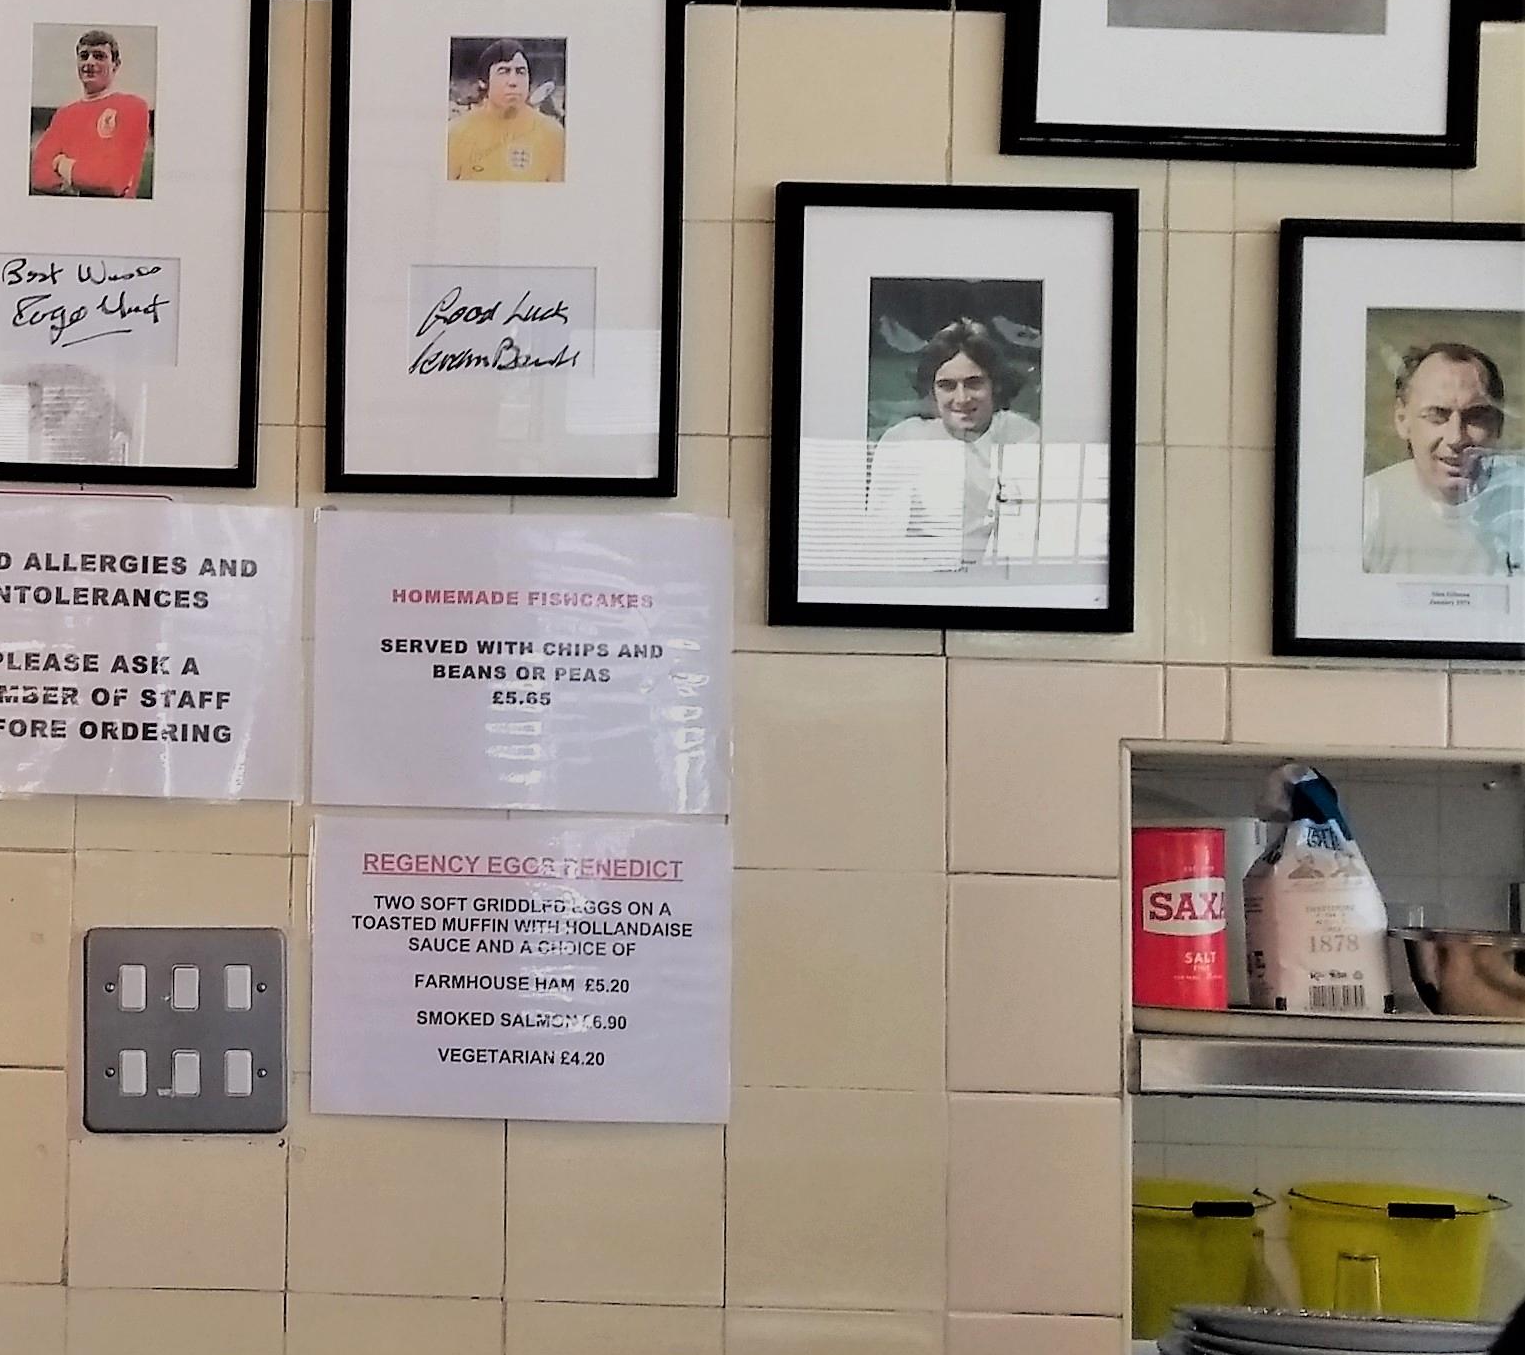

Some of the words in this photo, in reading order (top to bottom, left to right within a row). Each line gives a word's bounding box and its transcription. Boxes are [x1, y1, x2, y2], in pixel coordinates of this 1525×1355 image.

[23, 552, 188, 576] ALLERGIES
[198, 558, 259, 578] AND
[392, 588, 519, 607] HOMEMADE
[528, 591, 654, 610] FISHCAKES
[380, 638, 468, 656] SERVED
[477, 639, 534, 657] WITH
[543, 641, 610, 659] CHIPS
[617, 643, 664, 660] AND
[110, 655, 170, 676] ASK
[180, 656, 201, 676] A
[433, 663, 508, 681] BEANS
[516, 665, 547, 682] OR
[555, 666, 612, 683] PEAS
[91, 687, 128, 708] OF
[140, 688, 232, 711] STAFF
[79, 720, 232, 744] ORDERING
[363, 852, 481, 875] REGENCY
[373, 895, 415, 911] TWO
[421, 896, 469, 913] SOFT
[472, 897, 566, 914] GRIDDLED
[627, 900, 654, 917] ON
[352, 915, 437, 932] TOASTED
[442, 916, 509, 933] MUFFIN
[515, 918, 560, 934] WITH
[566, 920, 694, 938] HOLLANDAISE
[408, 937, 471, 955] SAUCE
[476, 938, 515, 954] AND
[537, 940, 607, 957] CHOICE
[612, 942, 637, 957] OF
[1309, 934, 1360, 954] 1878
[1184, 951, 1216, 964] SALT
[414, 974, 530, 992] FARMHOUSE
[535, 976, 576, 992] HAM
[584, 978, 630, 994] £5.20
[416, 1010, 495, 1028] SMOKED
[500, 1011, 578, 1029] SALMON
[437, 1047, 556, 1066] VEGETARIAN
[560, 1050, 606, 1067] £4.20
